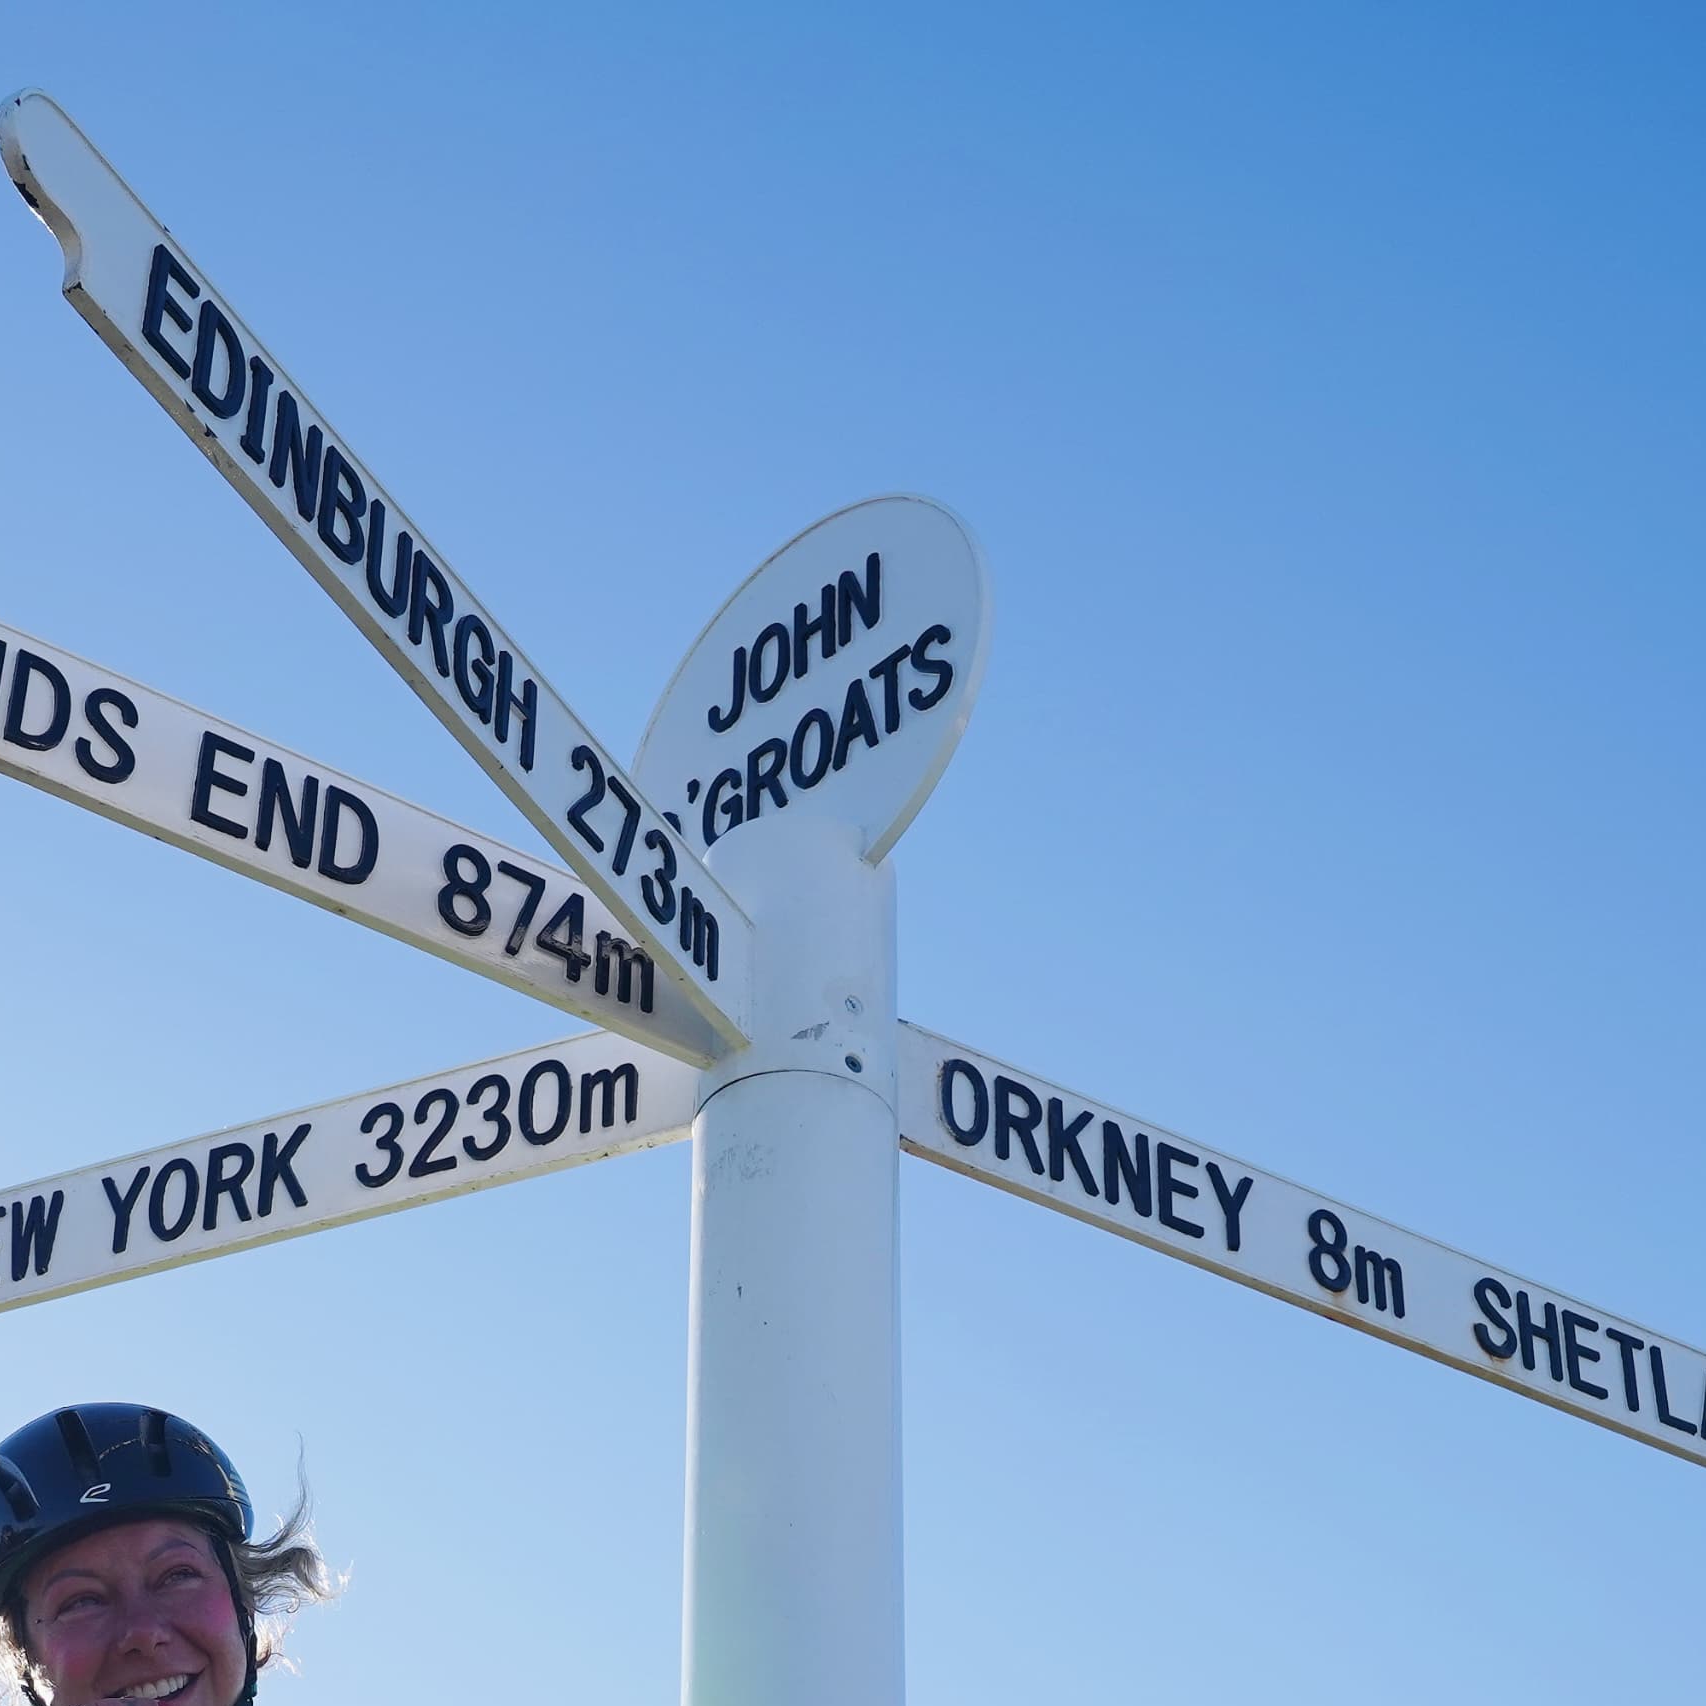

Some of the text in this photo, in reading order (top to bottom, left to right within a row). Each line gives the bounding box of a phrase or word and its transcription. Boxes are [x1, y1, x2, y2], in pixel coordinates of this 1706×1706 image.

[142, 243, 720, 982] EDINBURGH 273m
[707, 552, 881, 734] JOHN
[662, 624, 954, 848] 'GROATS
[190, 730, 379, 886] END
[437, 843, 655, 1014] 874m
[101, 1123, 312, 1255] YORK
[355, 1059, 639, 1189] 3230m
[938, 1058, 1254, 1252] ORKNEY
[1307, 1209, 1406, 1320] 8m
